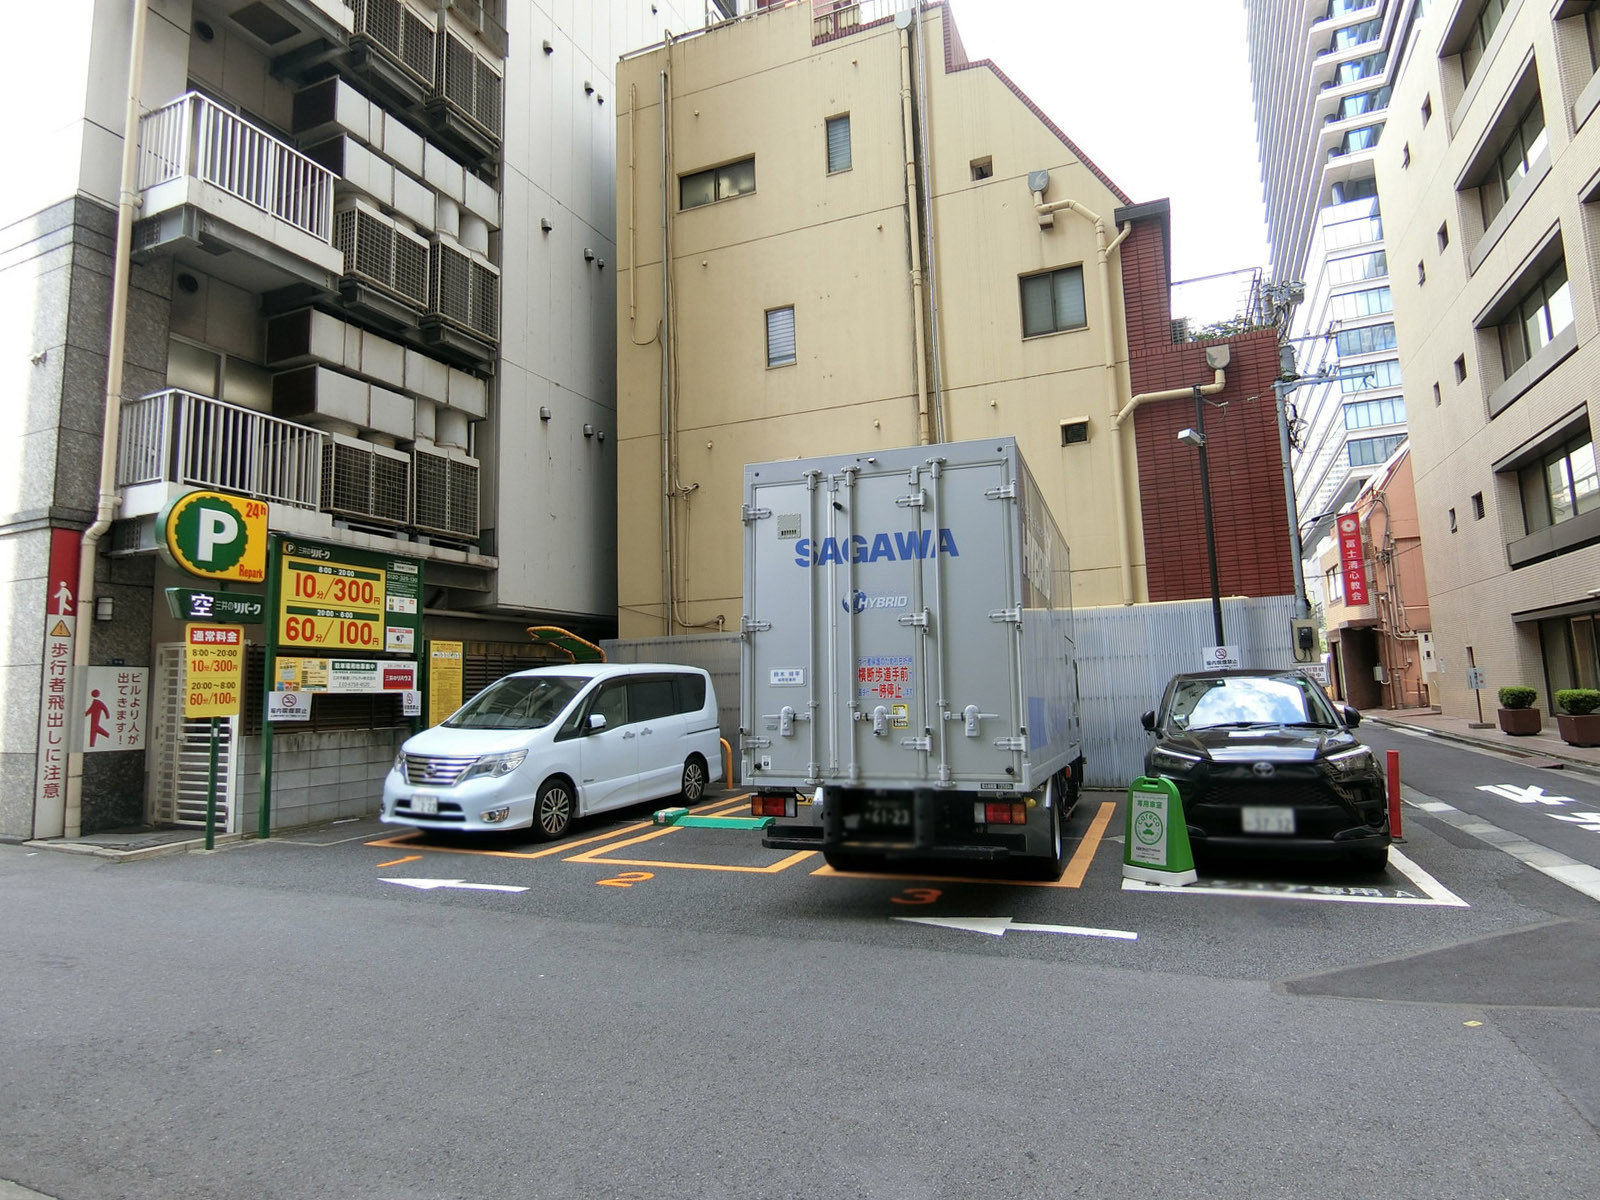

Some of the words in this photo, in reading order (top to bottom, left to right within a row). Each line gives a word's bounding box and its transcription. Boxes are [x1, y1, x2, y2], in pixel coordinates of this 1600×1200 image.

[246, 502, 266, 519] 24h
[197, 507, 238, 562] P
[795, 528, 960, 567] SAGAWA
[239, 564, 263, 579] Repark
[190, 593, 214, 617] 空
[216, 600, 261, 615] 三井のリパーク
[858, 595, 908, 609] HYBRID
[193, 630, 238, 643] 通常料金
[128, 672, 143, 745] ビルより人が
[43, 643, 69, 799] 歩行者飛出しに注意
[1138, 813, 1160, 828] careco
[595, 871, 655, 888] 2
[890, 888, 943, 905] 3
